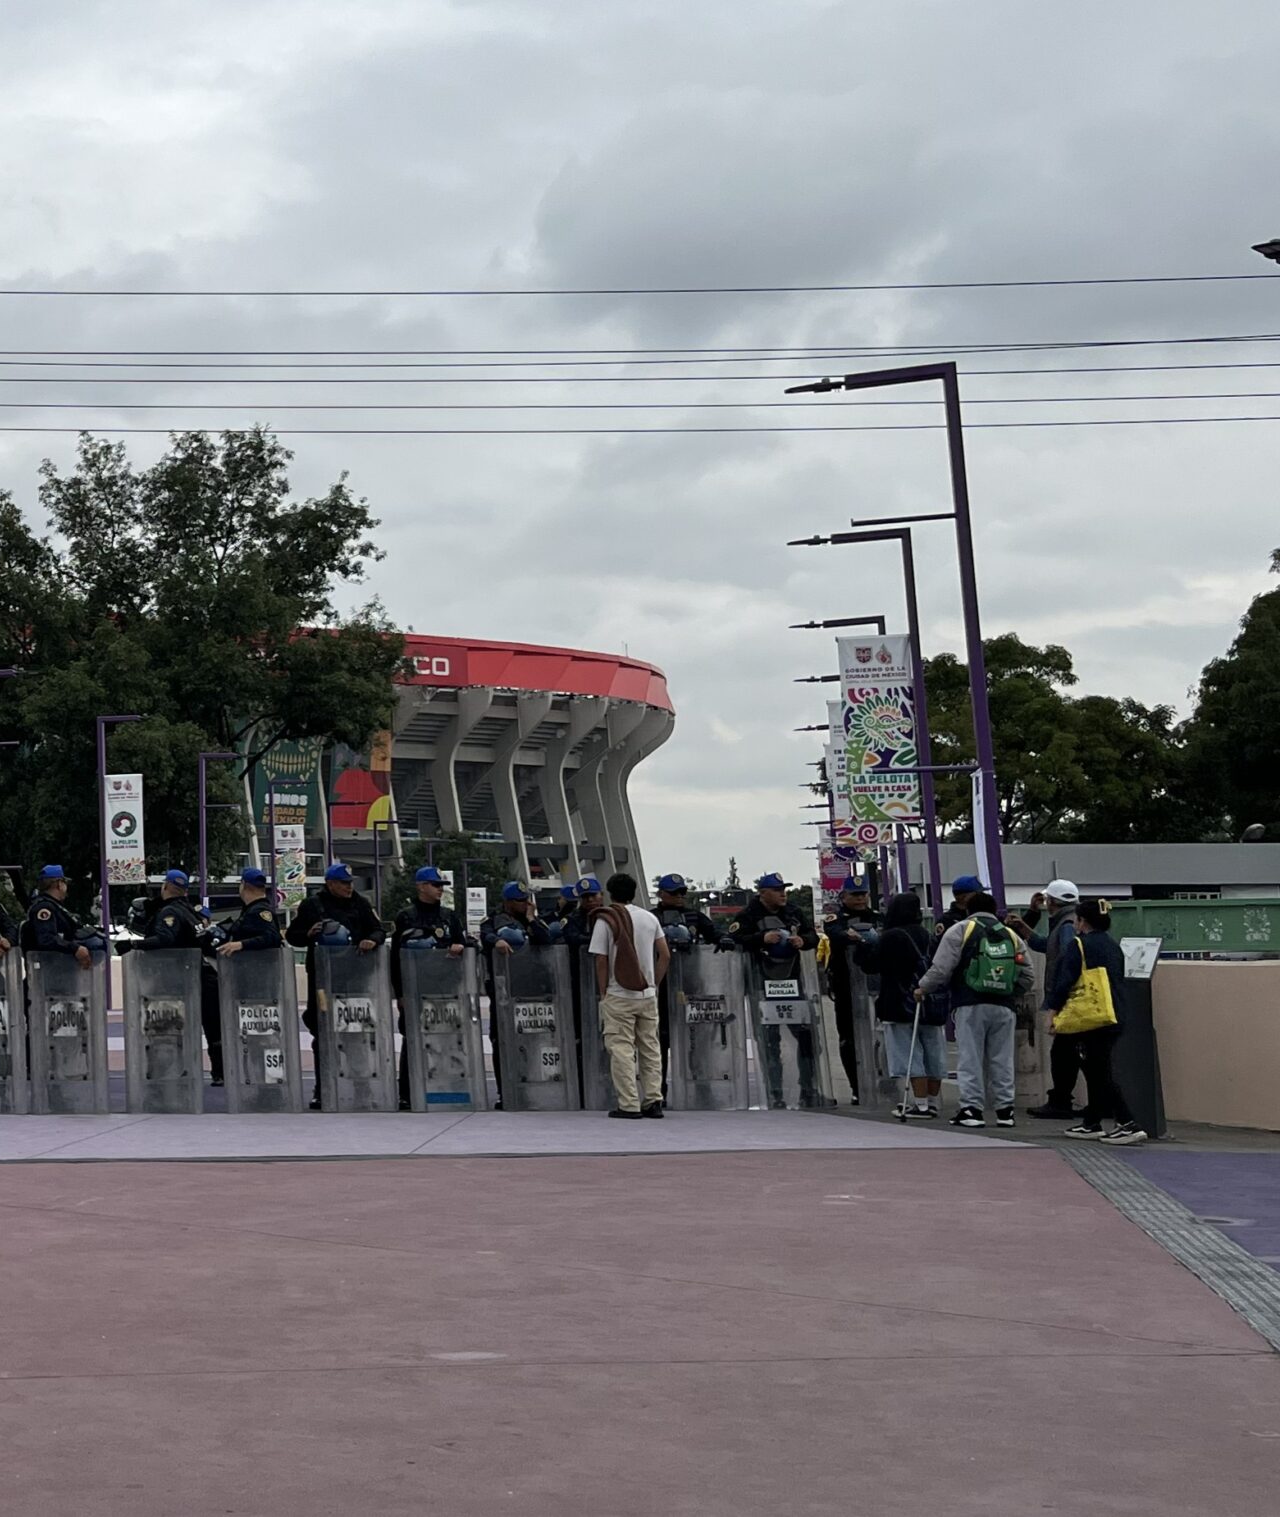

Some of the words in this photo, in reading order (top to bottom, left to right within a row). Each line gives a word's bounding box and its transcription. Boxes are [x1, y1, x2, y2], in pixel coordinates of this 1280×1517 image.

[853, 775, 866, 784] LA
[869, 774, 911, 784] PELOTA
[853, 785, 881, 793] VUELVE
[891, 784, 912, 792] CASA
[264, 793, 308, 806] SOMOS
[515, 1007, 553, 1017] POLICIA
[690, 1003, 721, 1011] POLICIA
[775, 1004, 793, 1013] SSC
[240, 1008, 279, 1018] POLICIA
[337, 1006, 370, 1024] POLICIA
[424, 1007, 457, 1025] POLICIA
[50, 1010, 86, 1028] POLICIA
[241, 1020, 280, 1031] AUXILIAR
[266, 1054, 284, 1068] SSP
[542, 1052, 560, 1066] SSP
